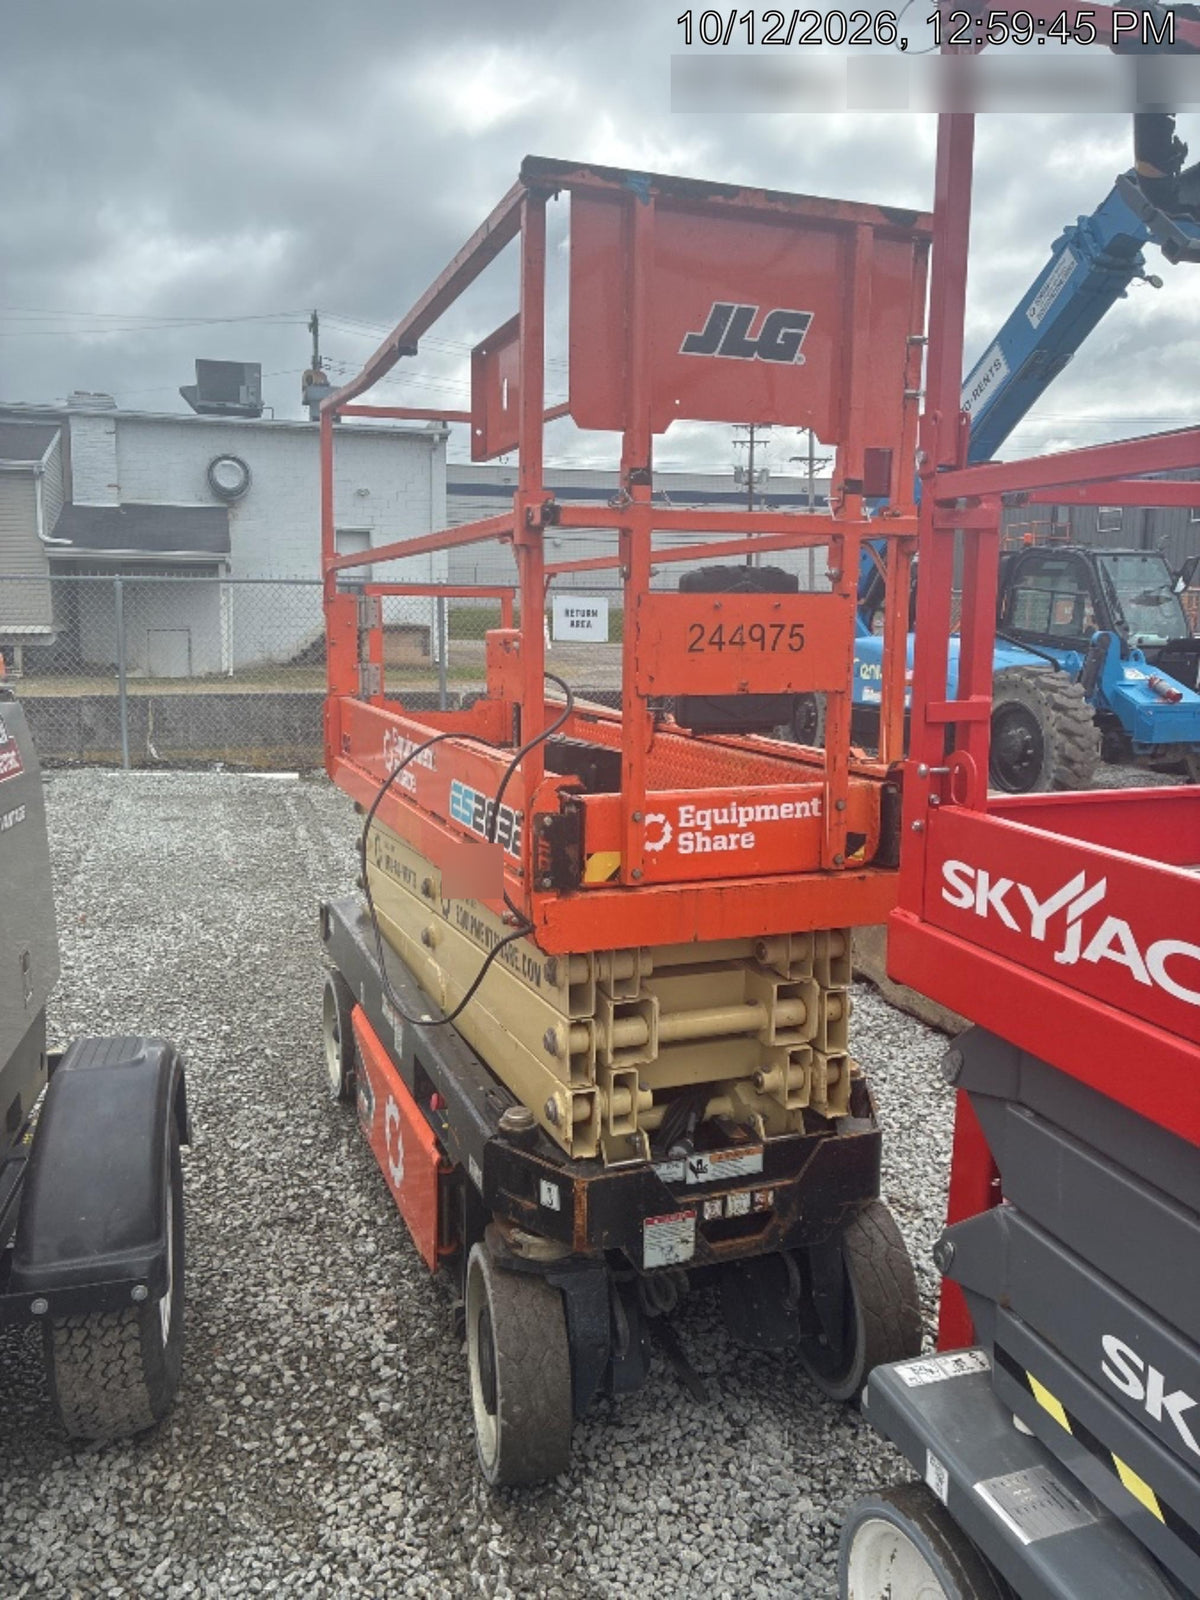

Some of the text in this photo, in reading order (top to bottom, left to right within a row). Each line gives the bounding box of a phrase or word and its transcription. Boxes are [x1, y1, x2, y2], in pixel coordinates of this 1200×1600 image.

[678, 301, 815, 365] JLG
[687, 623, 806, 653] 244975
[678, 797, 823, 832] Equipment
[677, 831, 756, 855] Share
